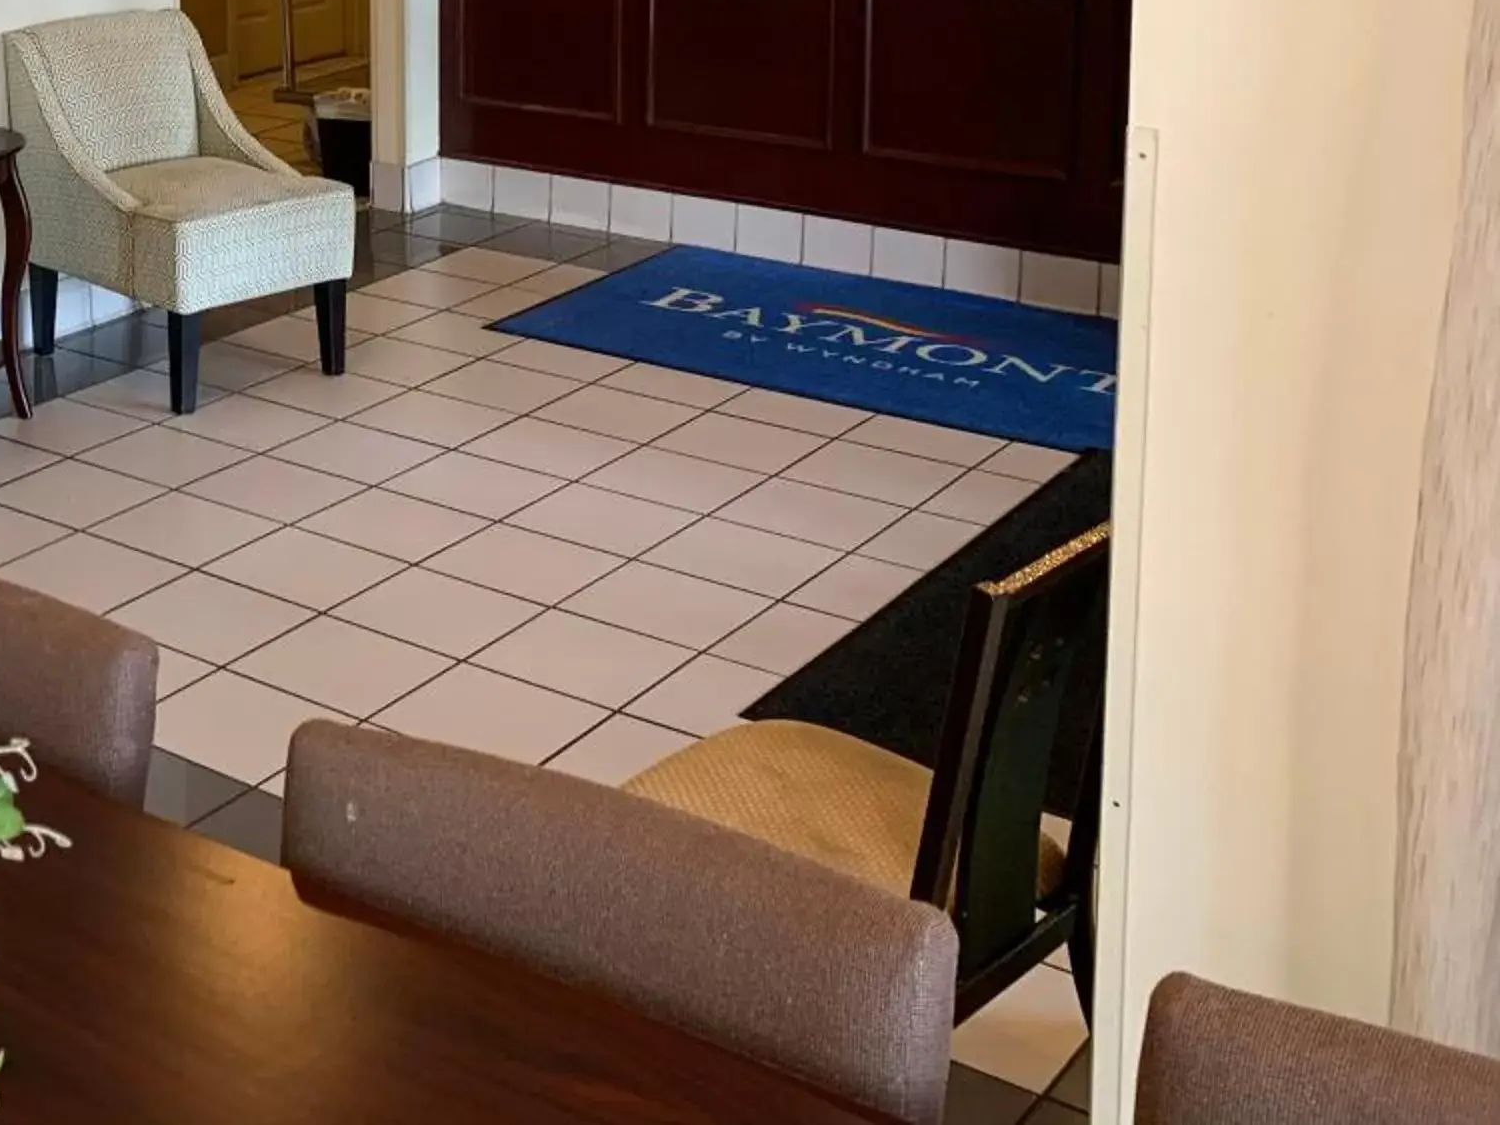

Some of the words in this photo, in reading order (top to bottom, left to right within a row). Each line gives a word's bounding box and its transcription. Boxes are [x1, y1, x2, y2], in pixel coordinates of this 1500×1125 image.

[639, 286, 1118, 395] BAYMONT
[722, 330, 768, 344] BY
[787, 342, 980, 388] WYNDHAM
